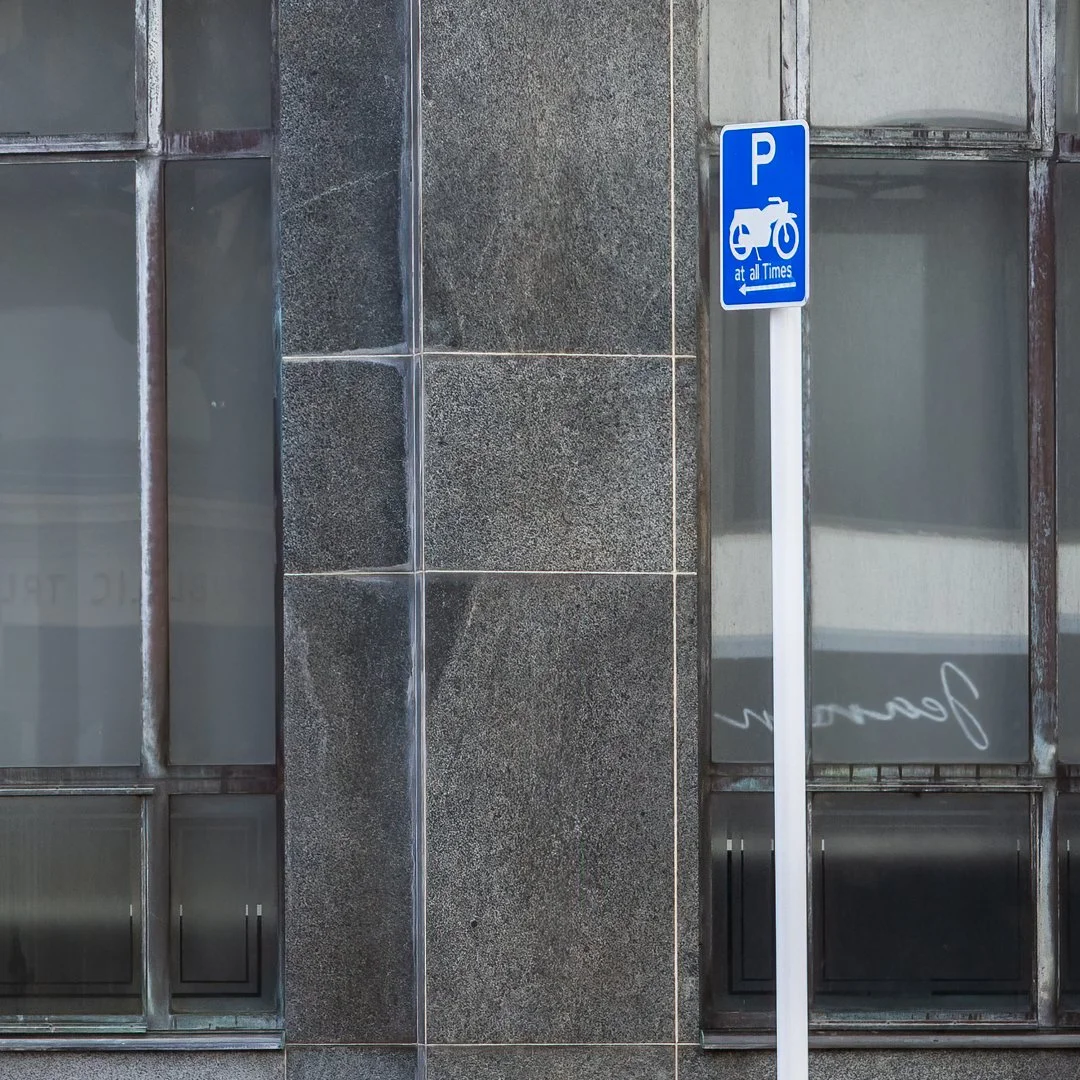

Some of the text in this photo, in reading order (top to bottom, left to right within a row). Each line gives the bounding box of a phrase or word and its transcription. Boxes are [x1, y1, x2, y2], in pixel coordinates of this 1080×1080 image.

[752, 132, 776, 185] P
[734, 263, 792, 281] at all Times
